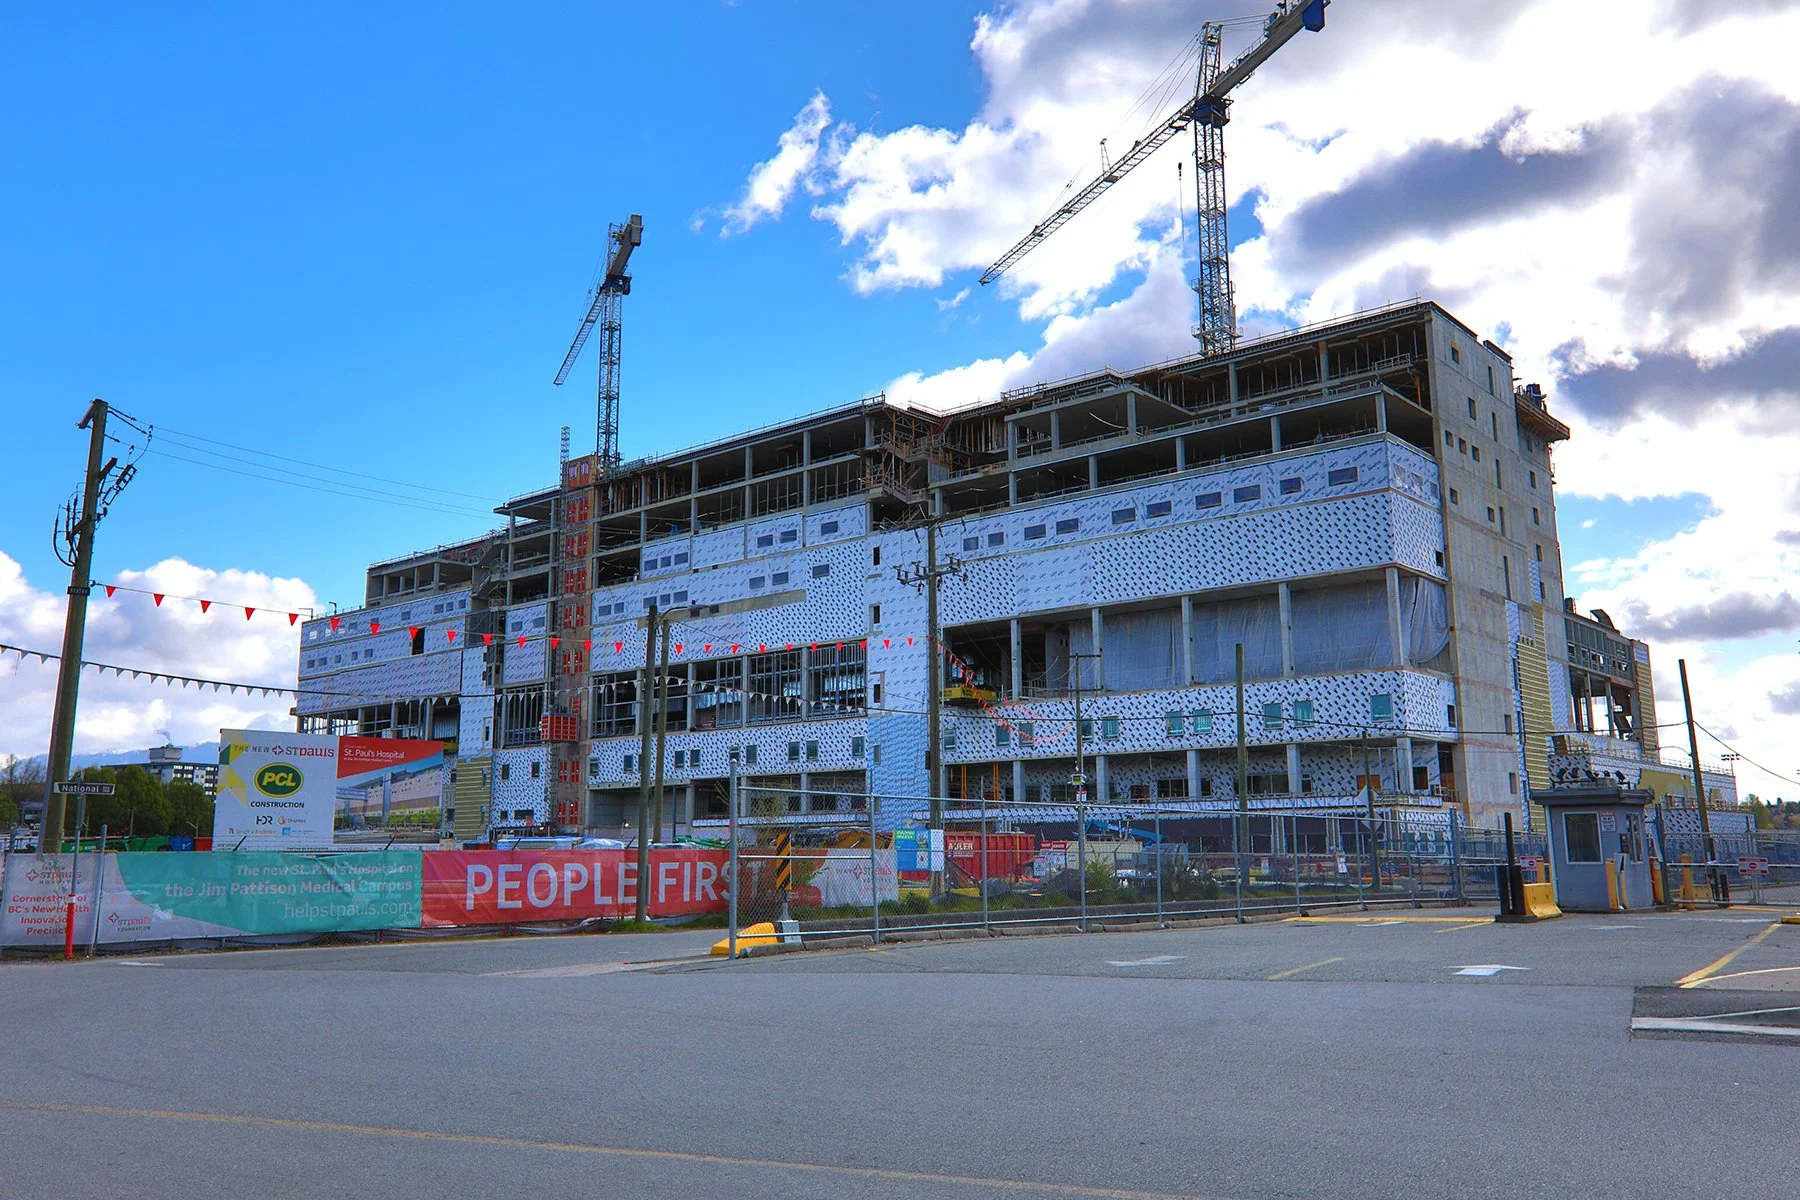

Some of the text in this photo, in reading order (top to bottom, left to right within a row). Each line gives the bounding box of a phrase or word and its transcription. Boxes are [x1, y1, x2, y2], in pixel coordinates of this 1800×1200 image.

[234, 744, 270, 753] THE NEW
[344, 748, 354, 757] St.
[376, 750, 405, 760] Hospital
[261, 771, 297, 787] PCL
[62, 784, 99, 793] National
[250, 800, 305, 809] CONSTRUCTION
[256, 815, 273, 826] HDR
[236, 864, 259, 876] The
[263, 866, 289, 876] new
[291, 863, 308, 876] St.
[349, 863, 397, 876] Hospital
[399, 864, 413, 874] on
[165, 879, 413, 897] the Jim Pattison Medical Campus
[465, 862, 638, 911] PEOPLE
[77, 893, 88, 903] of
[8, 905, 29, 913] BC's
[32, 905, 54, 913] New
[284, 901, 413, 921] helpstpauls.com
